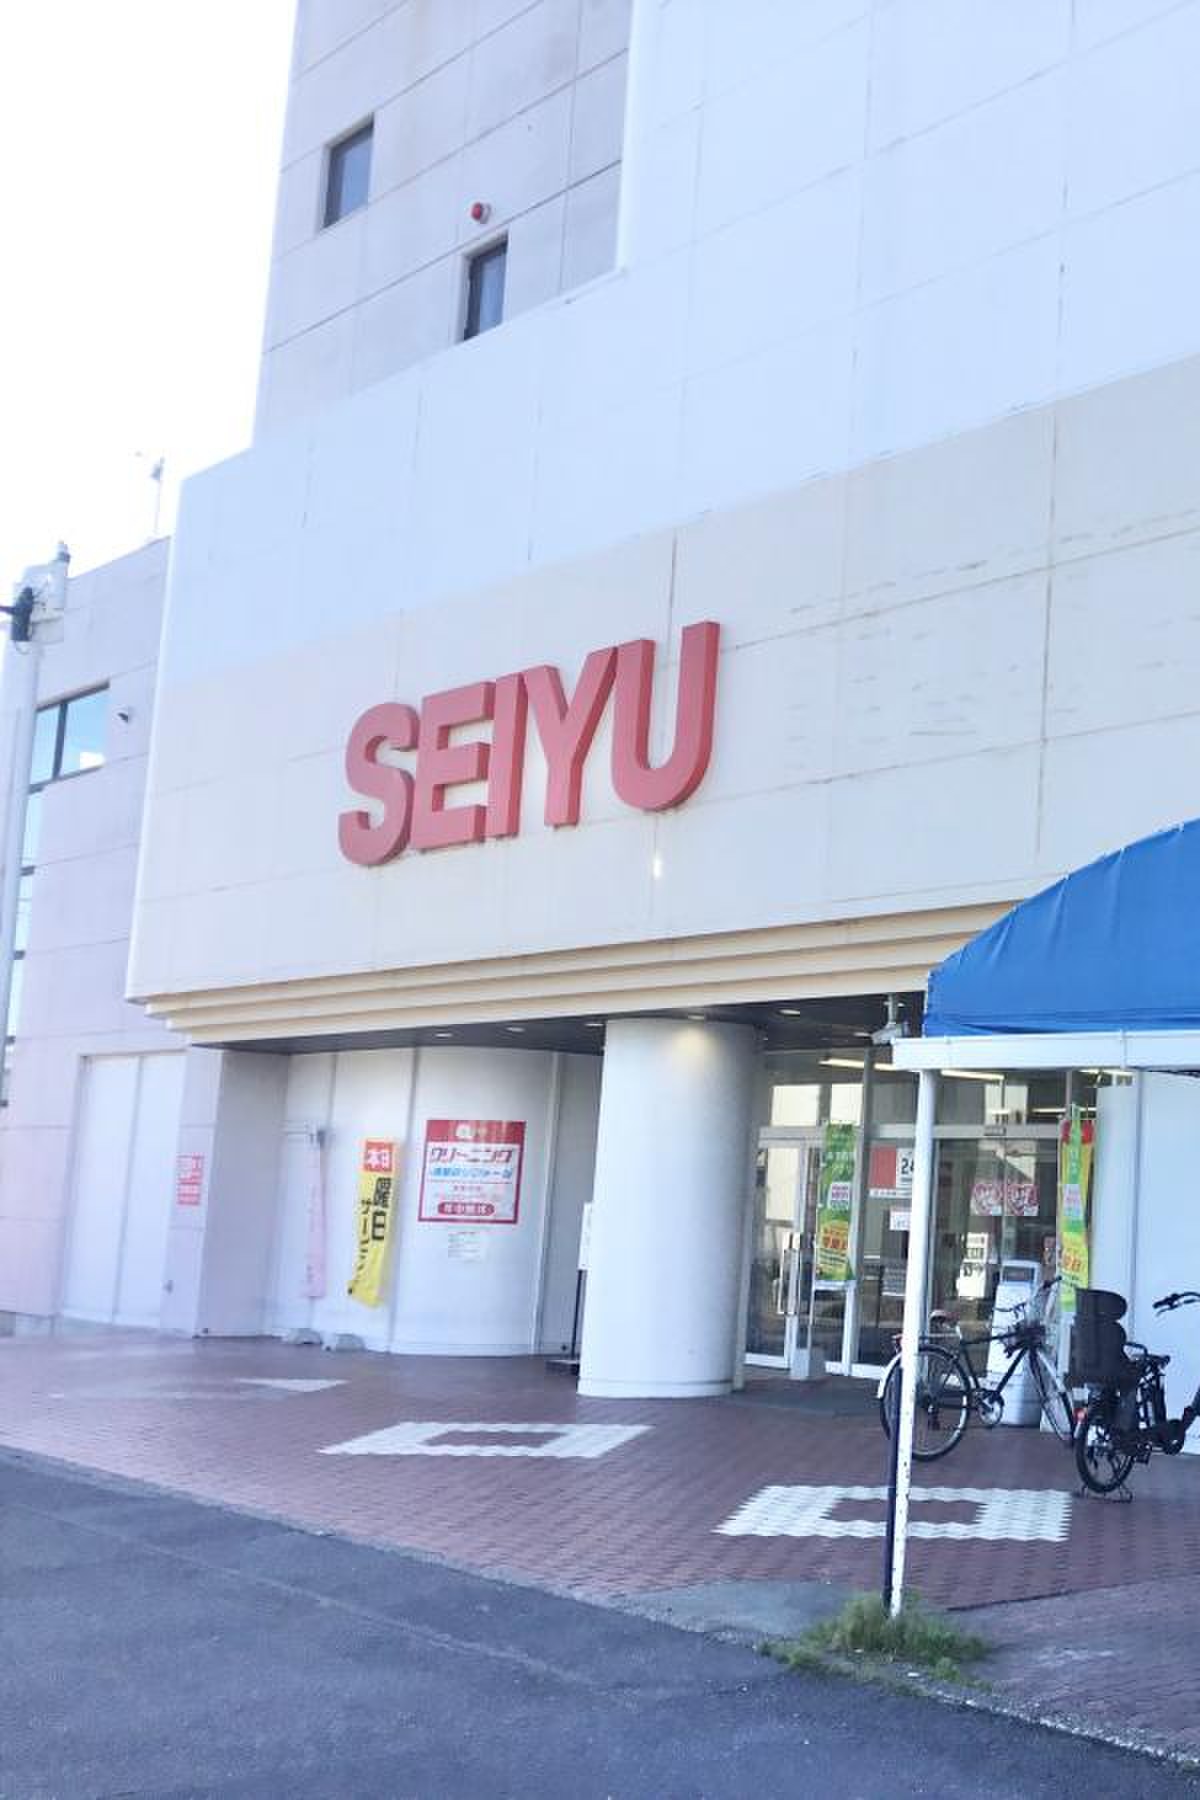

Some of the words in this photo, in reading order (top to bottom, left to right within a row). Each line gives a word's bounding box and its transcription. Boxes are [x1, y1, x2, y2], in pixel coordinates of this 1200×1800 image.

[338, 621, 721, 867] SEIYU
[431, 1147, 513, 1163] クリーニング
